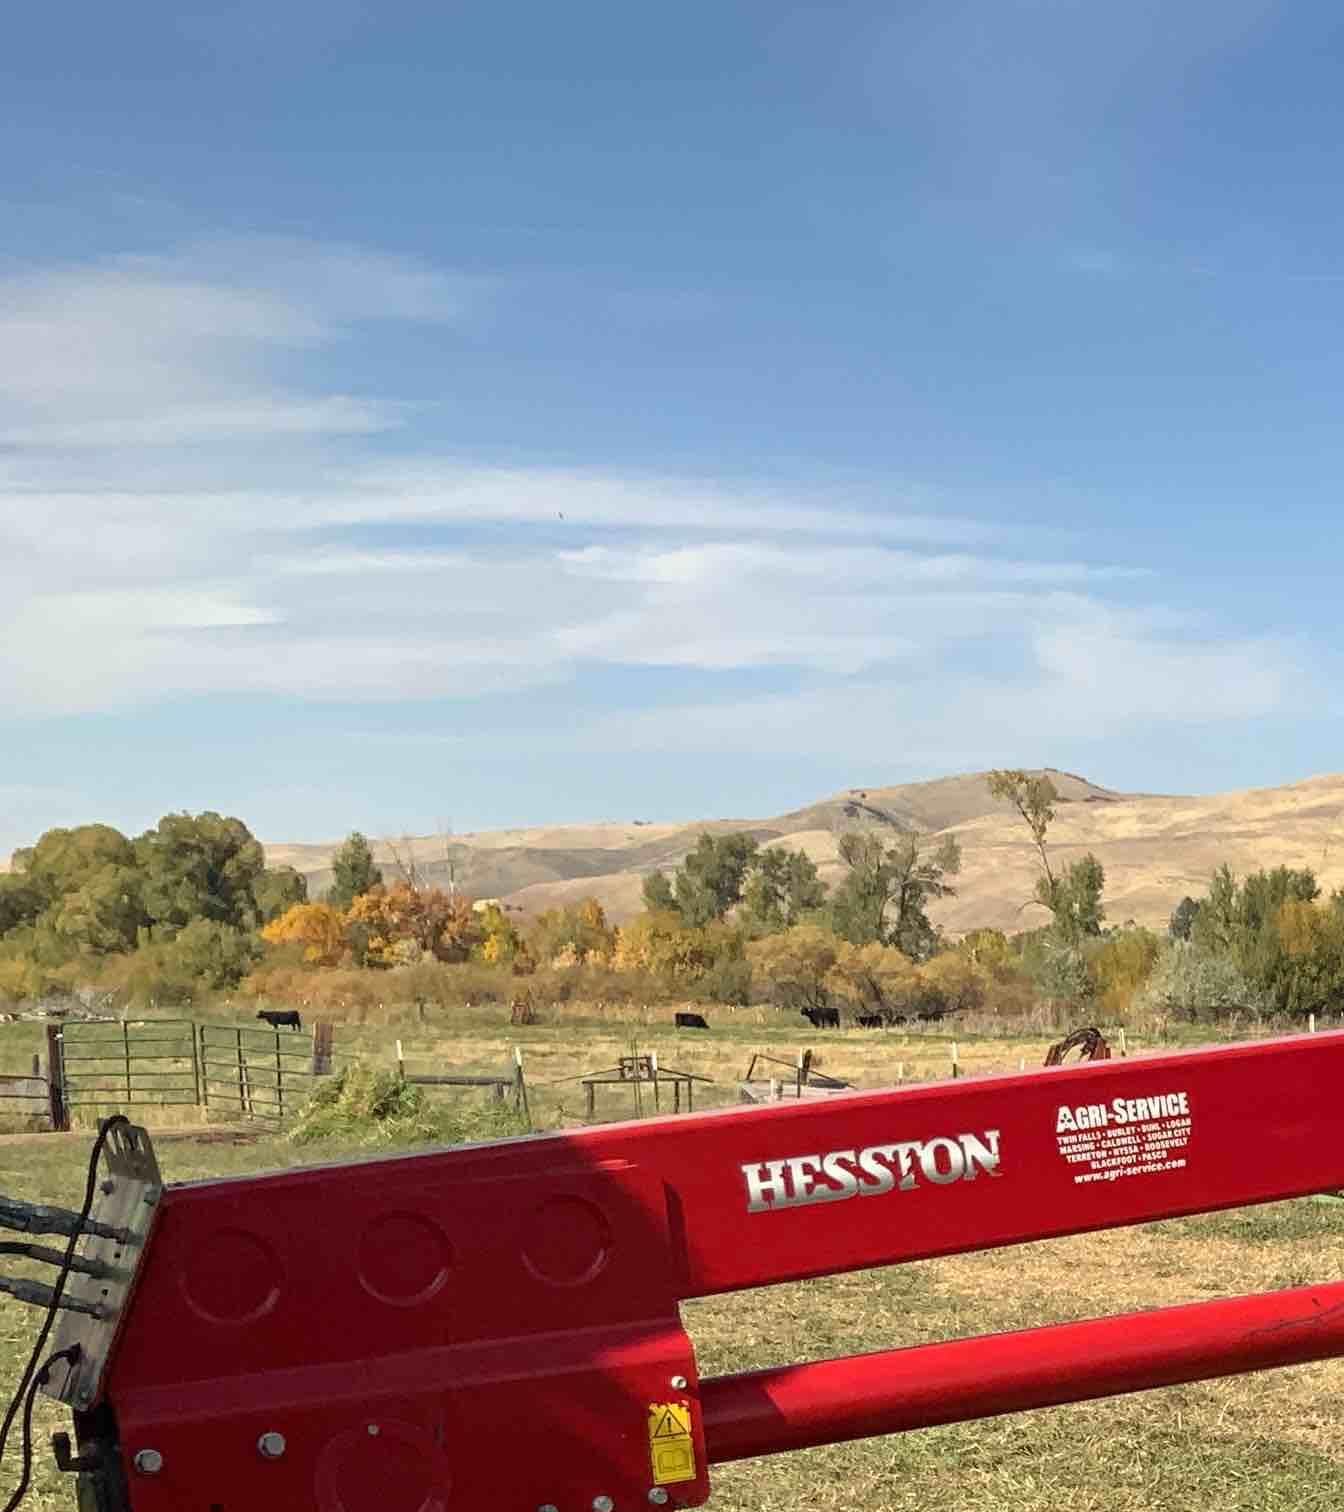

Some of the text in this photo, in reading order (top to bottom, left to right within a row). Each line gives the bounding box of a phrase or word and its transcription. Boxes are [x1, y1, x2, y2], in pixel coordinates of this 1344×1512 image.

[1056, 1134, 1078, 1146] TWIN
[1078, 1131, 1102, 1143] FALLS
[1173, 1127, 1191, 1137] CITY
[741, 1129, 1003, 1213] HESSTON
[1074, 1158, 1187, 1184] www.agri-service.com
